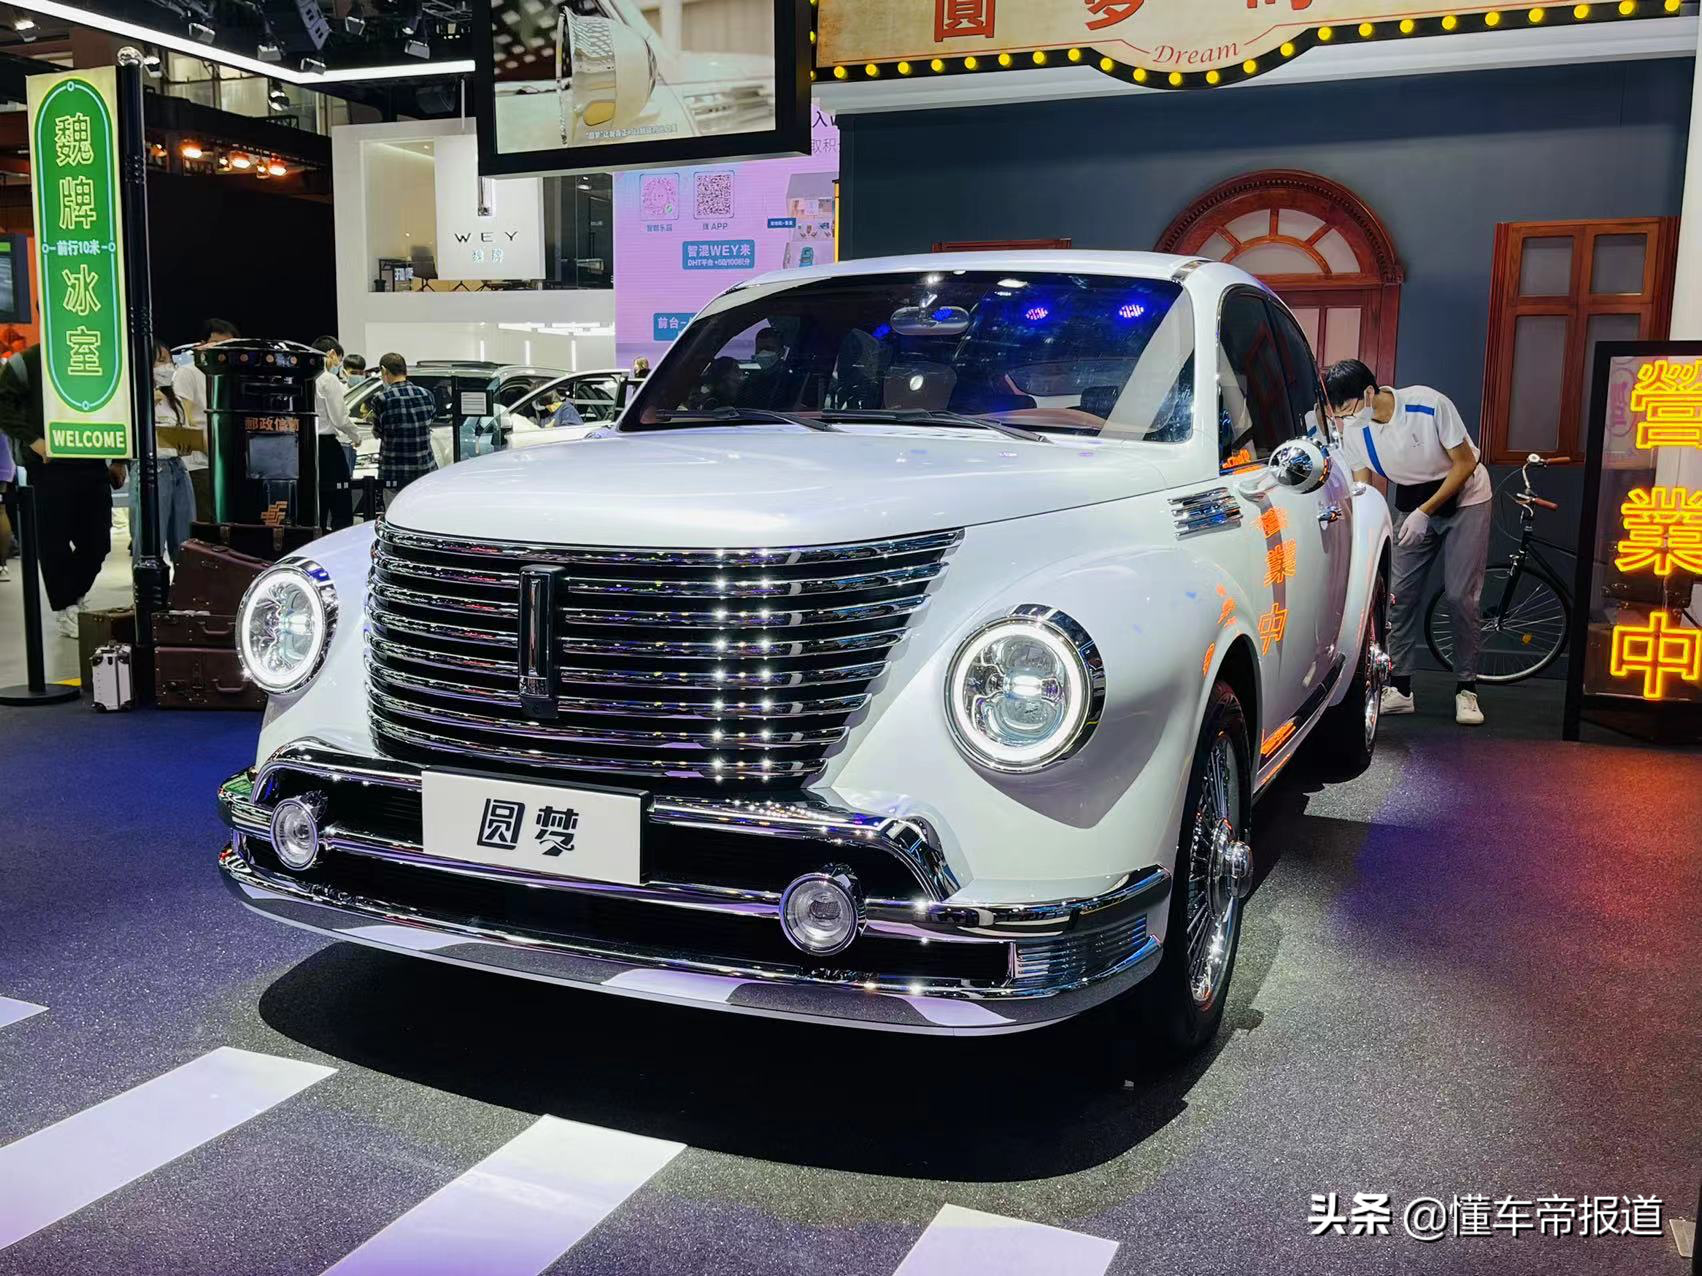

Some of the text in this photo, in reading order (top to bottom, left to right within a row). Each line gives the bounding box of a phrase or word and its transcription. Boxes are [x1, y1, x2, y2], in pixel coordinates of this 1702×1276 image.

[1153, 42, 1240, 64] Dream
[55, 112, 96, 229] 魏牌
[454, 231, 518, 243] WEY
[62, 264, 102, 375] 冰室
[52, 430, 125, 448] WELCOME
[1610, 359, 1702, 699] 營業中
[477, 798, 580, 857] 圆梦
